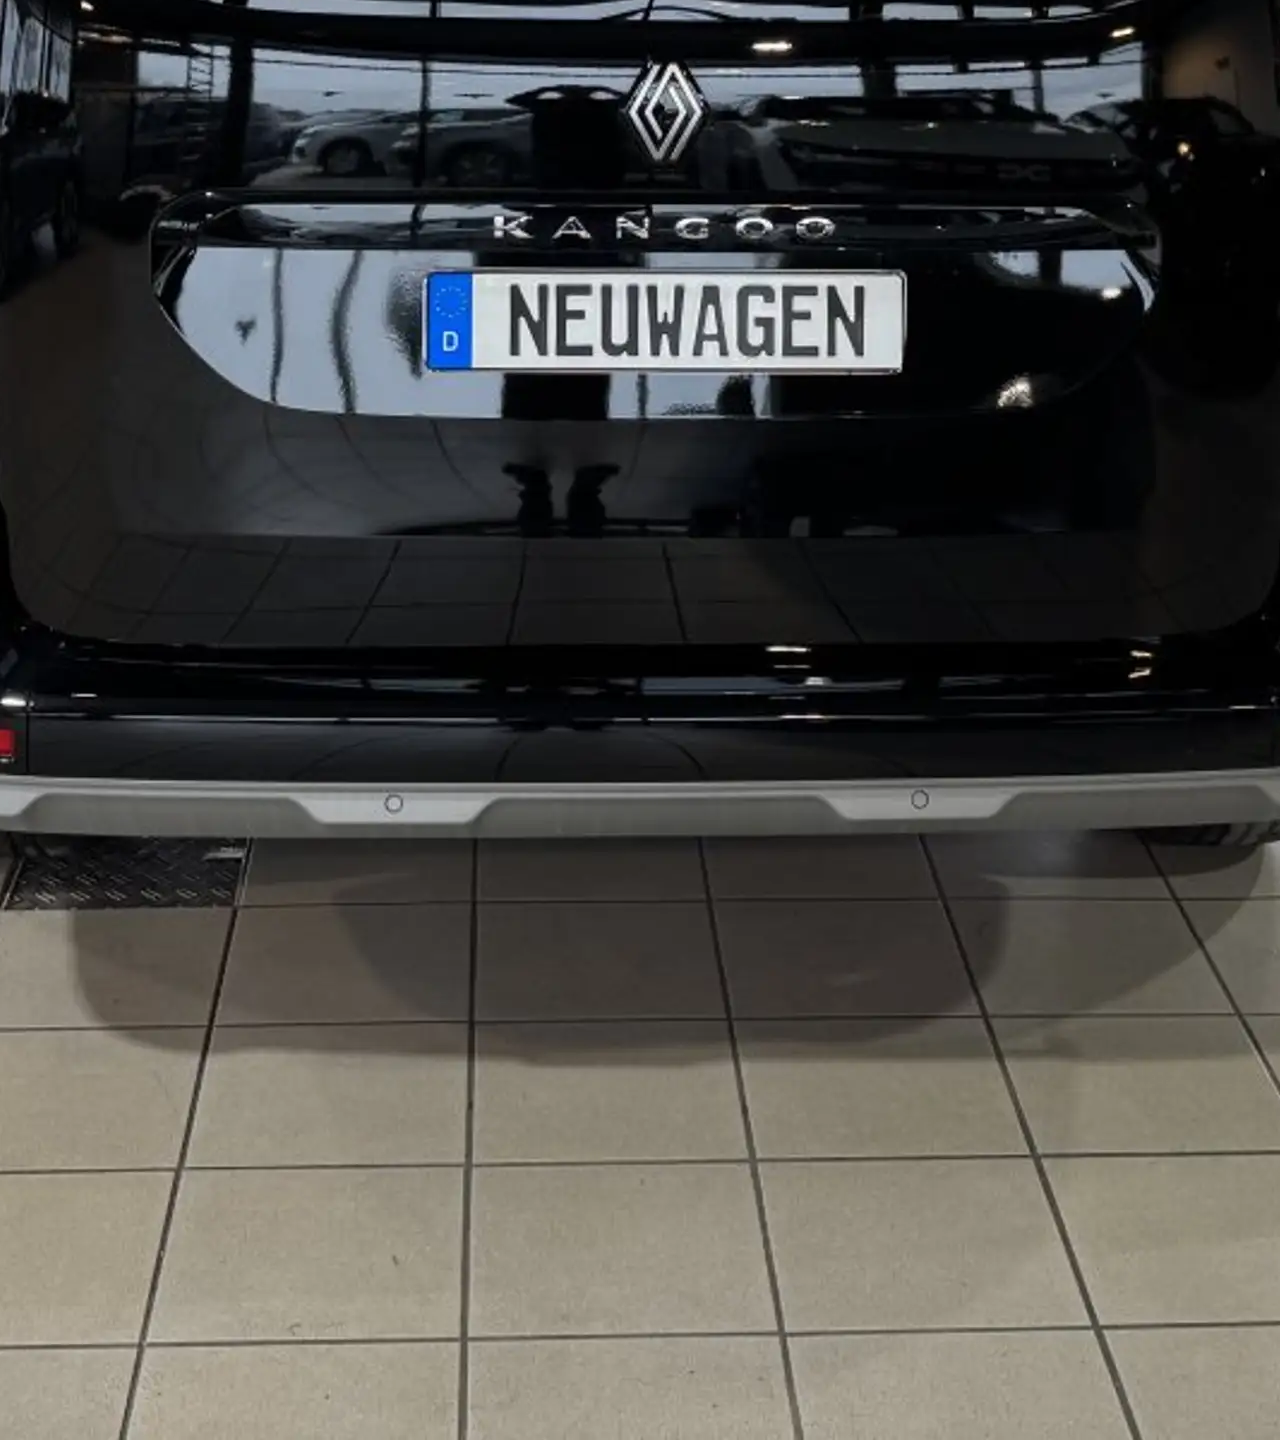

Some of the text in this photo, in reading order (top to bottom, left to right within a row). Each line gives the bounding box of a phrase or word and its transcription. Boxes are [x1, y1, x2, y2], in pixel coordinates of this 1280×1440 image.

[492, 215, 836, 240] KANGOO
[509, 283, 866, 358] NEUWAGEN
[441, 330, 459, 352] D
